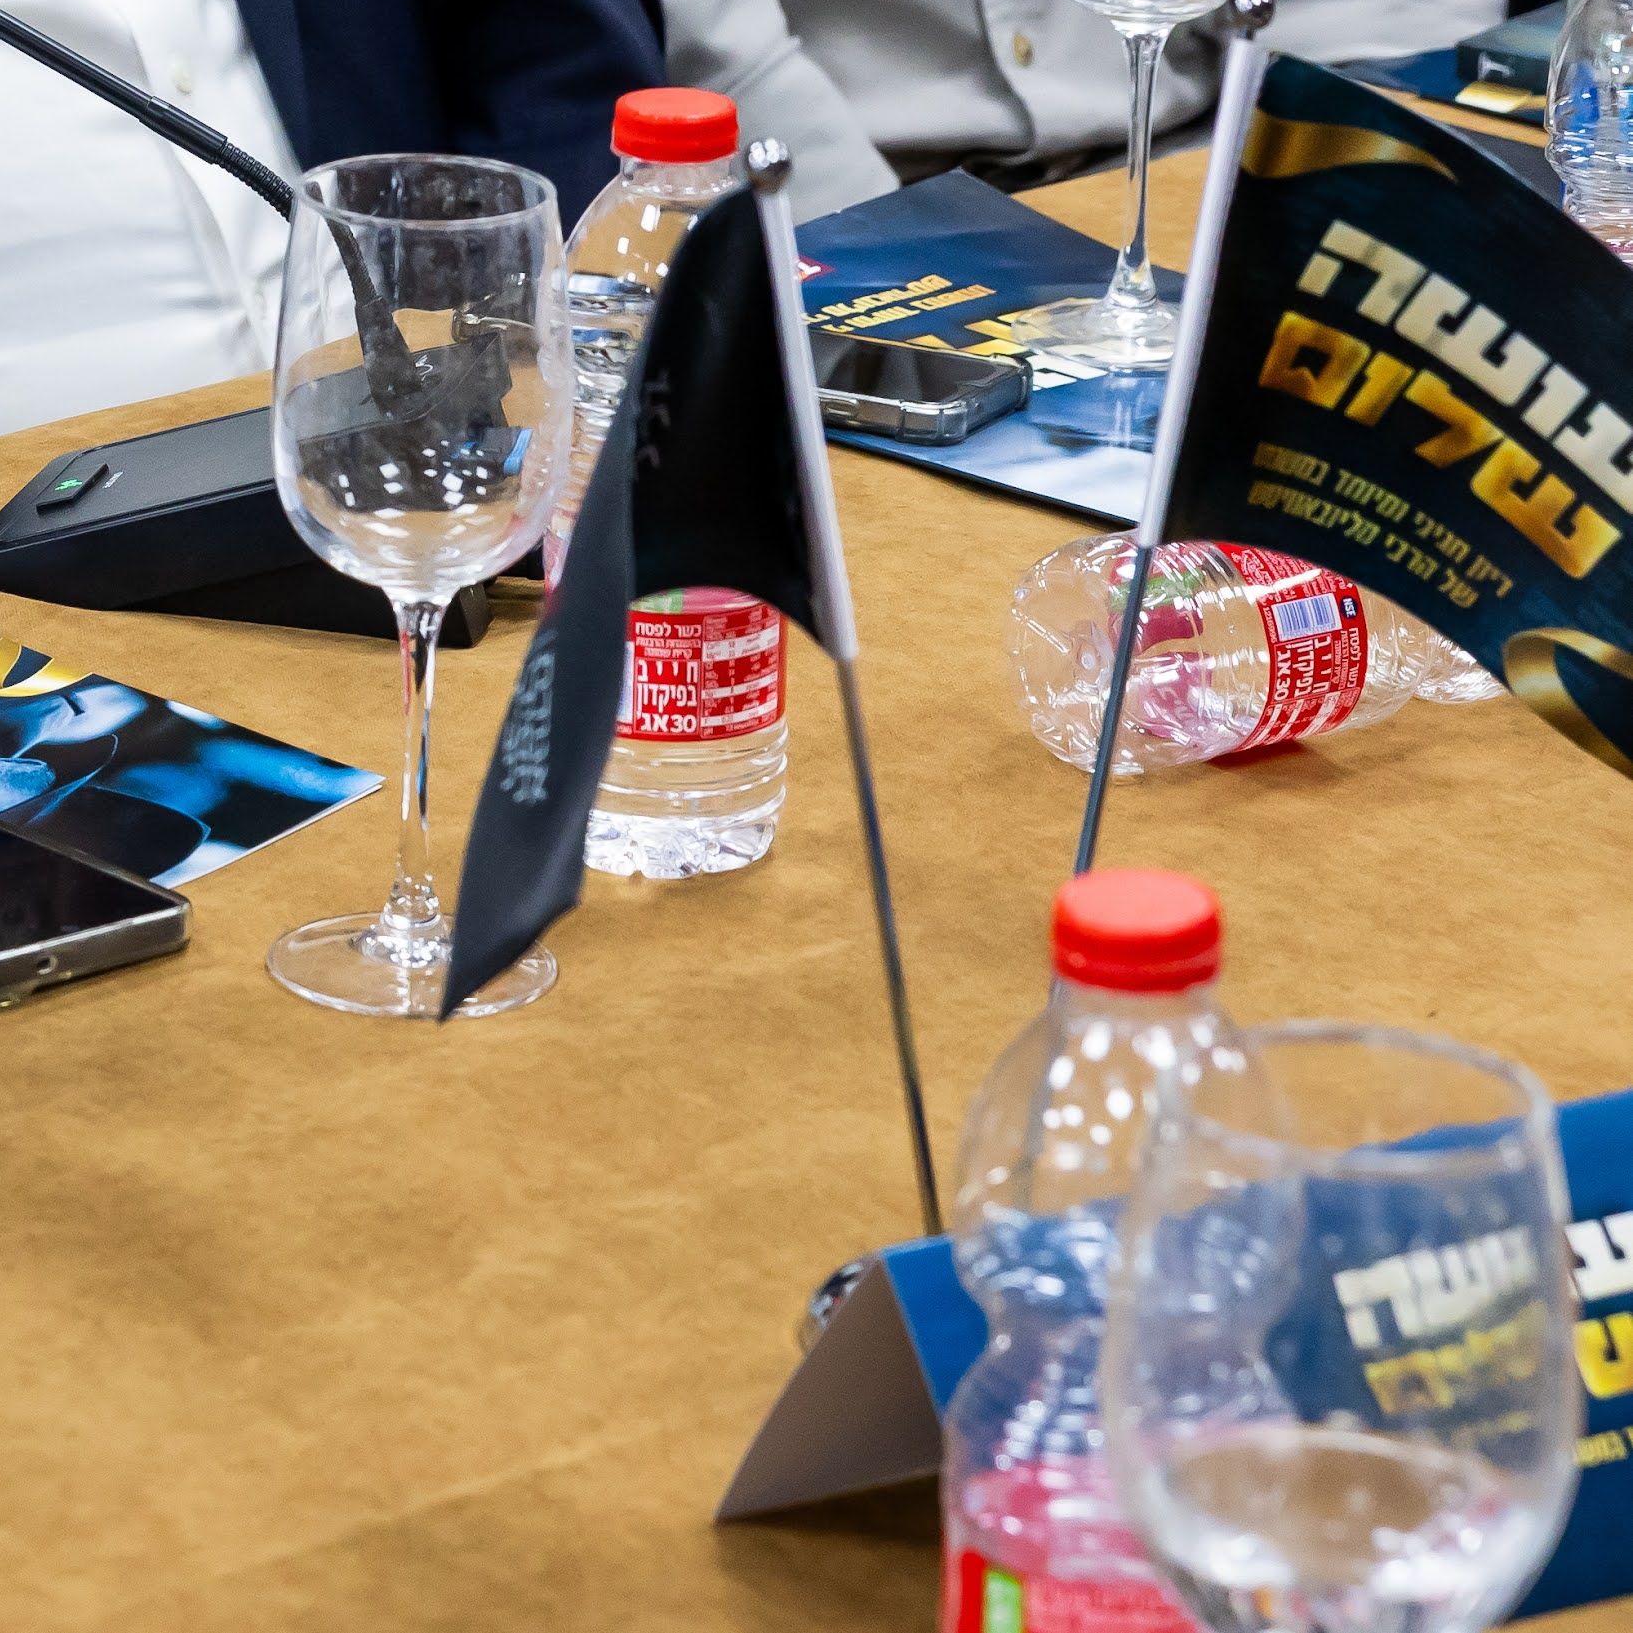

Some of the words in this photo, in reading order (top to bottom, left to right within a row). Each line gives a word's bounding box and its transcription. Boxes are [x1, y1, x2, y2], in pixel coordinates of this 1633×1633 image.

[1259, 310, 1622, 580] שלום
[1385, 533, 1440, 580] הרבי
[1438, 569, 1479, 608] של
[635, 621, 672, 637] לפסח
[675, 623, 701, 640] כשר
[1349, 627, 1362, 662] לפסח
[1291, 639, 1314, 698] בפיקדון
[637, 683, 697, 718] בפיקדון
